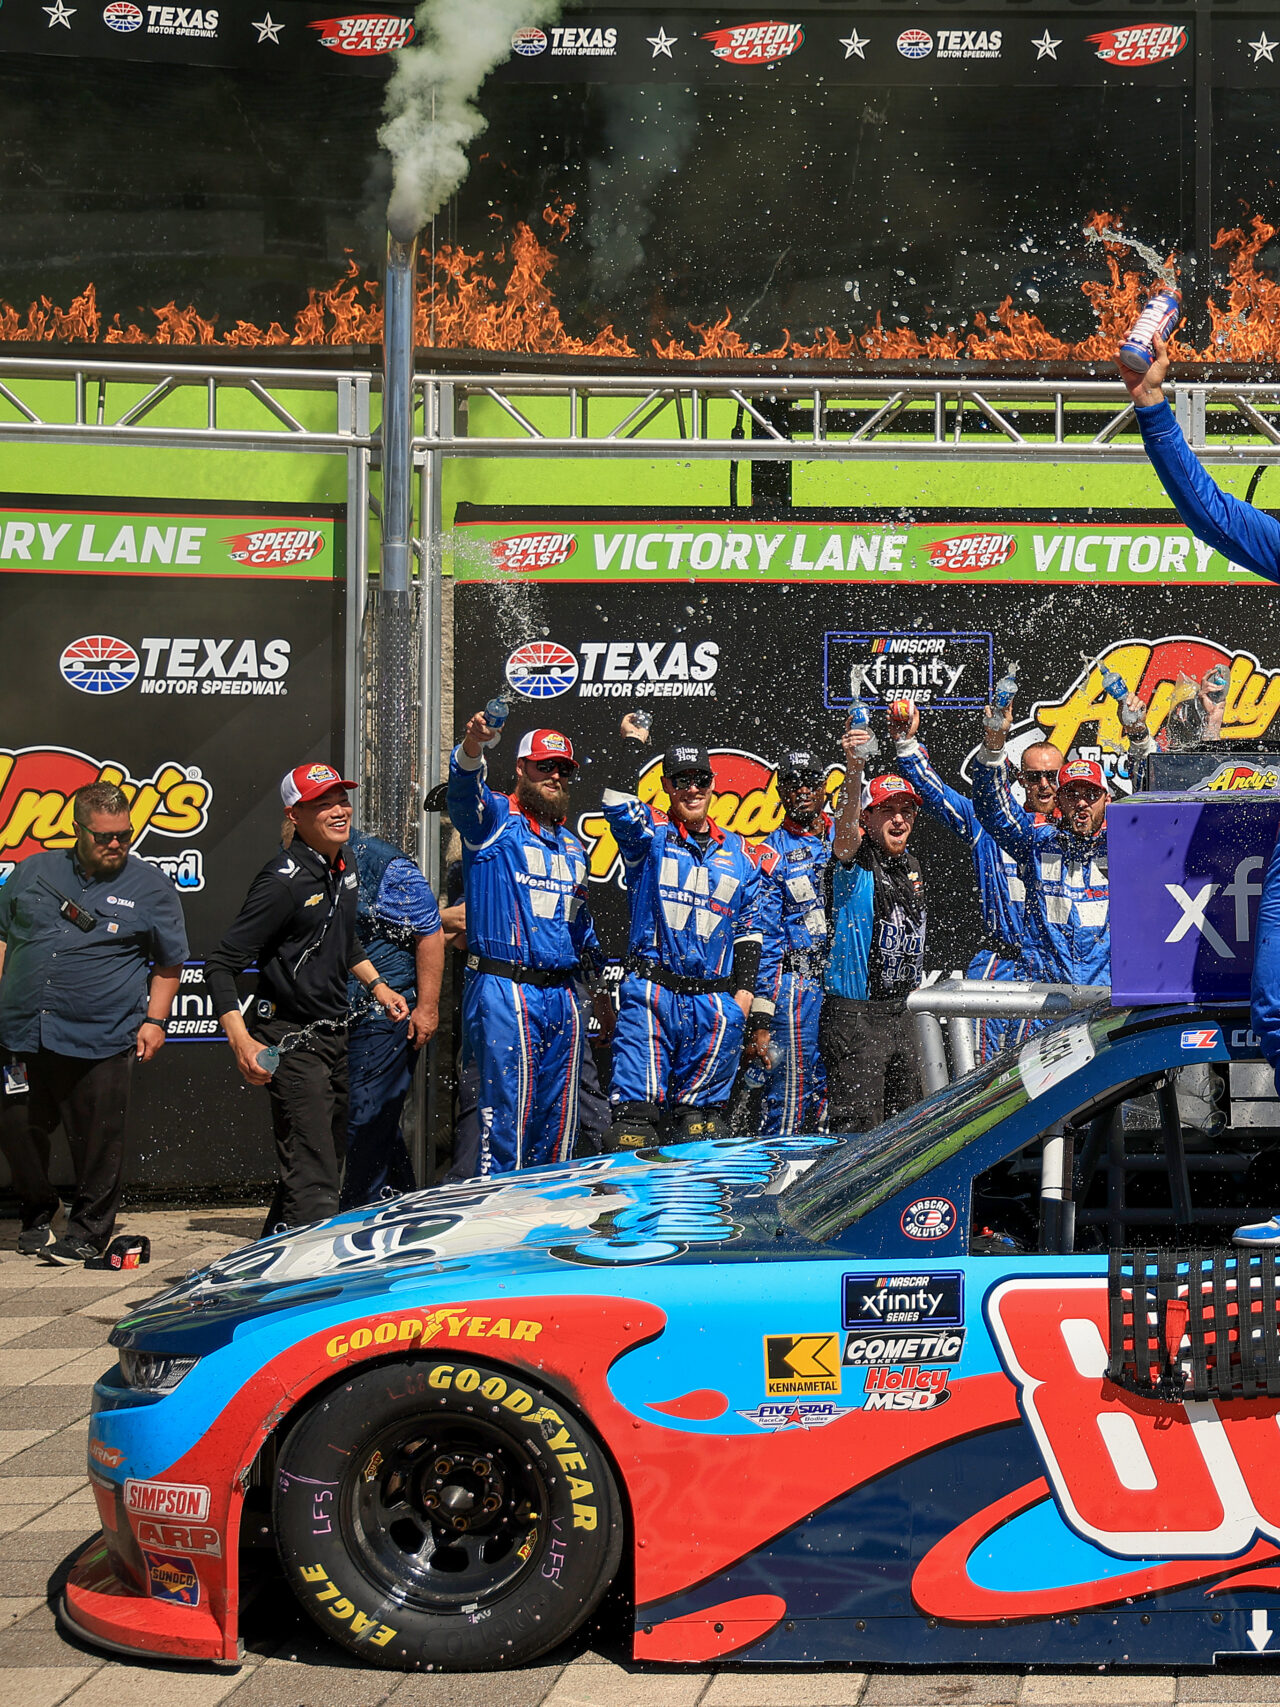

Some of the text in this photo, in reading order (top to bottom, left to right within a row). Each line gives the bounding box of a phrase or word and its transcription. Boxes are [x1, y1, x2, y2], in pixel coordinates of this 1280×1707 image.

[147, 5, 219, 29] TEXAS
[338, 16, 413, 38] SPEEDY
[147, 25, 217, 38] MOTOR SPEEDWAY
[551, 28, 617, 49] TEXAS
[731, 24, 801, 46] SPEEDY
[937, 31, 1001, 50] TEXAS
[1114, 26, 1185, 48] SPEEDY
[341, 35, 404, 52] CA$H
[551, 47, 615, 56] MOTOR SPEEDWAY
[733, 42, 795, 59] CA$H
[1116, 43, 1178, 61] CA$H
[937, 50, 1001, 59] MOTOR SPEEDWAY
[77, 524, 206, 564] LANE
[248, 529, 321, 551] SPEEDY
[505, 533, 576, 555] SPEEDY
[946, 533, 1013, 554] SPEEDY
[251, 548, 314, 563] CA$H
[507, 551, 568, 567] CA$H
[593, 533, 908, 571] VICTORY LANE
[949, 552, 1007, 569] CA$H
[1033, 535, 1215, 573] VICTORY
[890, 639, 946, 653] NASCAR
[141, 638, 291, 679] TEXAS
[579, 642, 719, 681] TEXAS
[852, 656, 967, 695] xfinity
[141, 680, 283, 695] MOTOR SPEEDWAY
[579, 683, 712, 698] MOTOR SPEEDWAY
[885, 689, 931, 702] SERIES
[675, 747, 698, 756] Blues
[678, 753, 697, 763] Hog
[1206, 767, 1279, 791] Andy's
[660, 889, 732, 917] eatherTech
[167, 1020, 218, 1034] SERIES
[909, 1197, 951, 1215] NASCAR
[905, 1222, 950, 1238] SALUTES
[890, 1276, 930, 1287] NASCAR
[862, 1290, 943, 1317] xfinity
[886, 1312, 919, 1323] SERIES
[325, 1309, 543, 1358] GOODYEAR
[847, 1334, 961, 1360] COMETIC
[768, 1381, 837, 1393] KENNAMETAL
[866, 1366, 950, 1392] Holley
[759, 1403, 833, 1416] FIVE STAR
[863, 1390, 940, 1411] MSD
[429, 1364, 598, 1532] GOODYEAR
[129, 1484, 201, 1516] SIMPSON
[138, 1523, 220, 1551] ARP
[152, 1566, 194, 1586] SUNOCO
[300, 1563, 398, 1647] EAGLE
